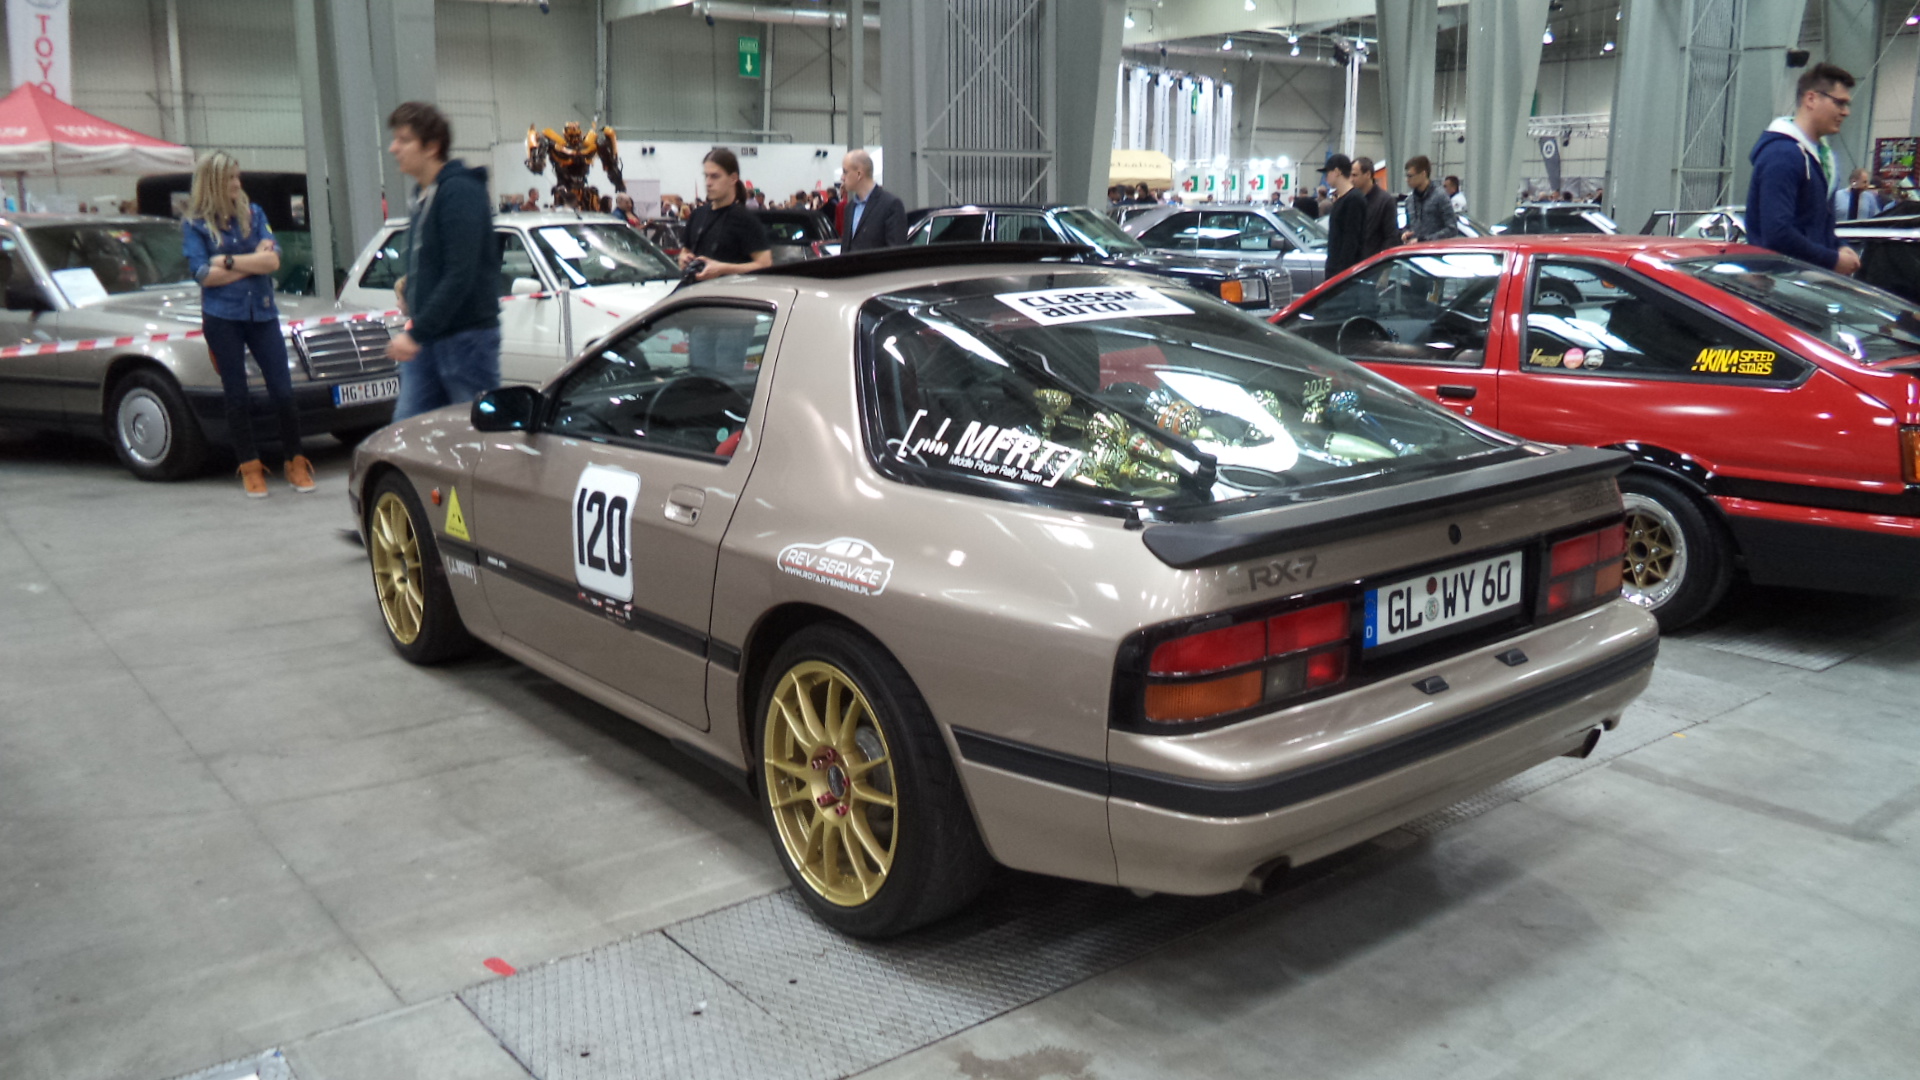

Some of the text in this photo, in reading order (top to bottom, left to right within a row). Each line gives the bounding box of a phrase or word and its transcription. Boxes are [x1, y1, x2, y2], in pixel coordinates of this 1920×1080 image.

[1691, 348, 1776, 373] AKINA SPEED
[1737, 363, 1773, 375] STARS
[341, 380, 397, 401] HG ED 192
[948, 455, 1043, 483] Middle Finger Rally Team
[577, 488, 628, 578] 120
[786, 548, 882, 585] REV SERVICE
[1248, 554, 1318, 592] RX-7
[1388, 586, 1423, 634] GL
[1442, 569, 1476, 619] WY
[1482, 560, 1512, 606] 60
